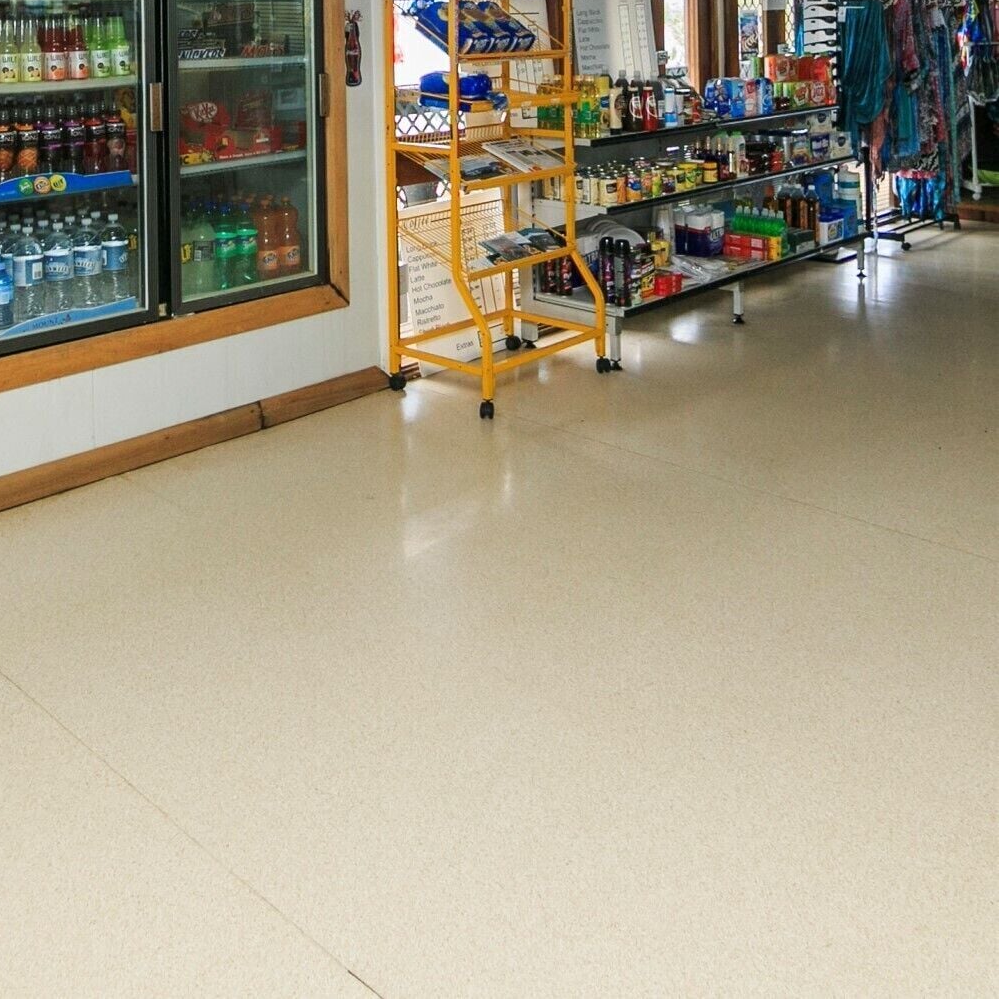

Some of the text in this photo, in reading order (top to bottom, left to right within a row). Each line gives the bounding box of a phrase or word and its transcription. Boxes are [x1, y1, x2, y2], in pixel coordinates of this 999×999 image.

[412, 285, 423, 294] Hot
[413, 294, 433, 306] Mocha
[456, 340, 474, 351] Extras
